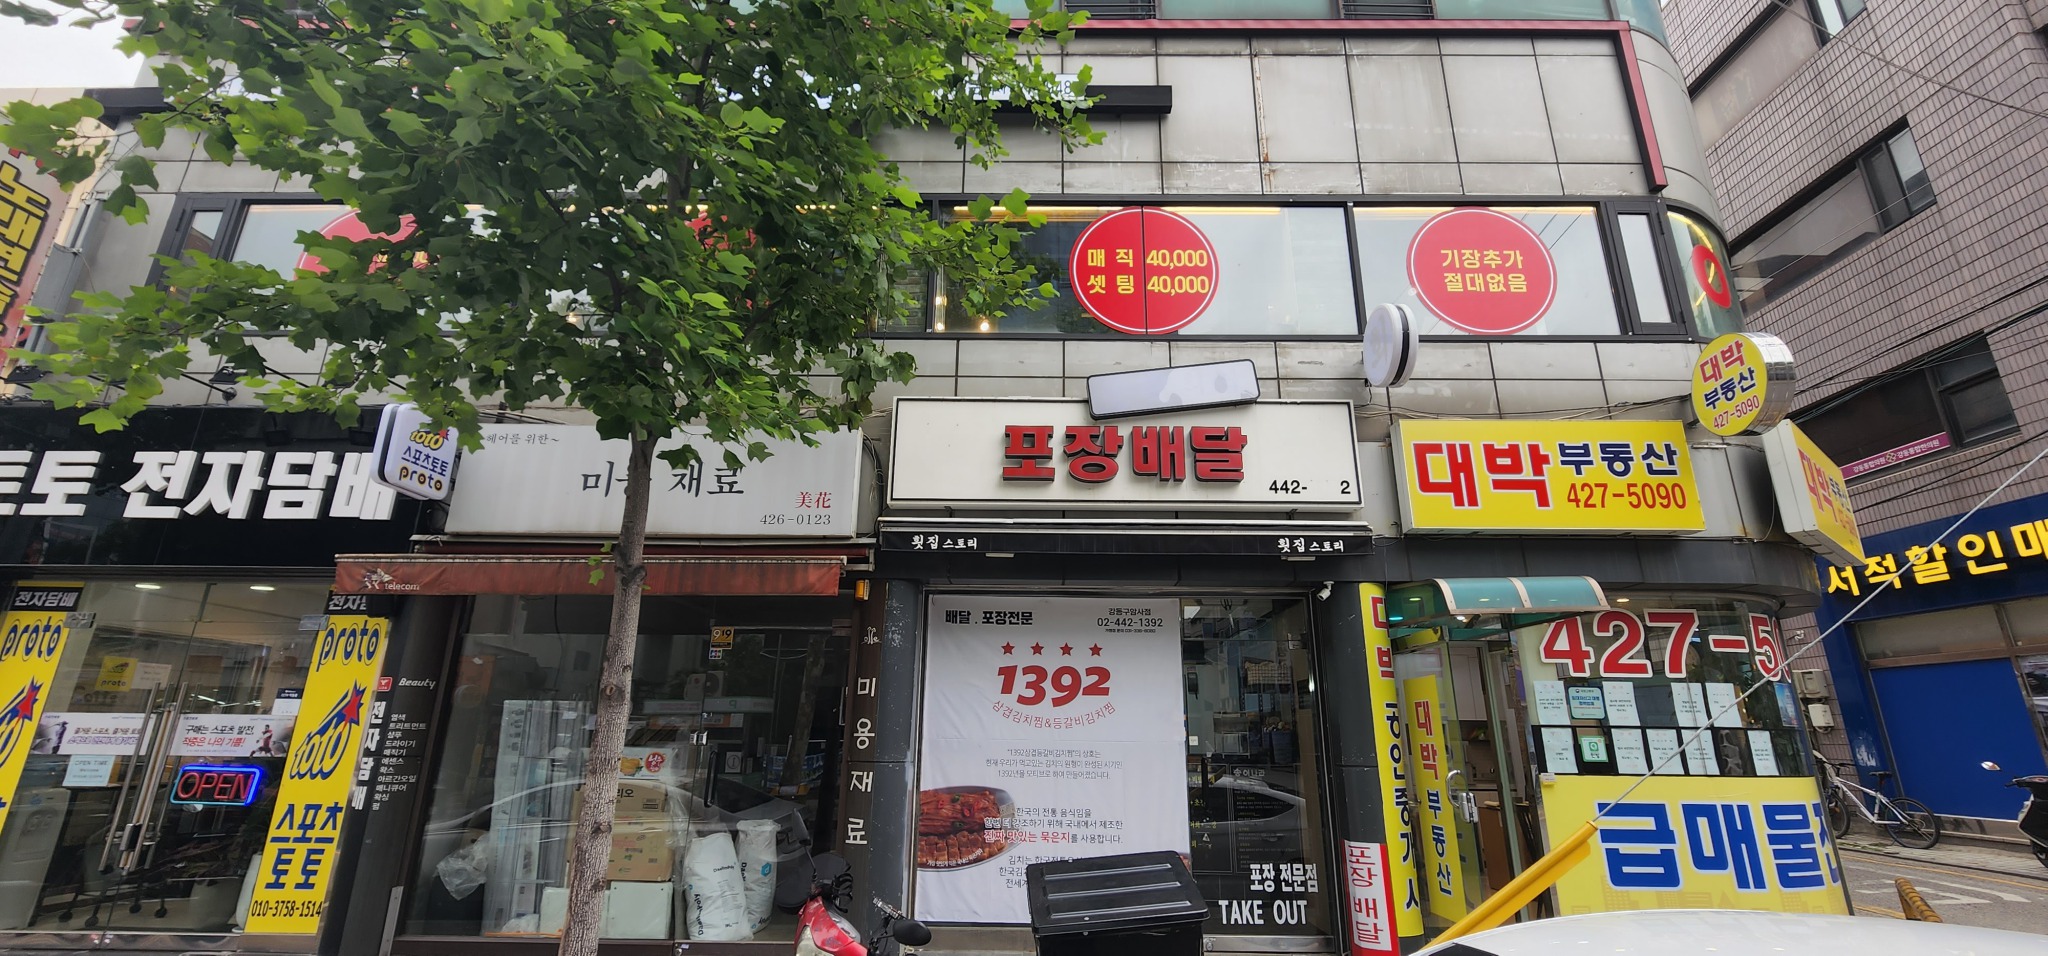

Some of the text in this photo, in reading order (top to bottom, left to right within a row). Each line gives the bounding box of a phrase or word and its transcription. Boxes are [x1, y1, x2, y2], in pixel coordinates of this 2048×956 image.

[1146, 250, 1208, 270] 40,000
[1440, 249, 1523, 269] 기장추가
[1147, 276, 1209, 296] 40,000
[1443, 272, 1528, 293] 절대없음
[1699, 339, 1745, 384] 대박
[1703, 366, 1756, 410] 부동산
[1713, 394, 1760, 430] 427-5090
[410, 429, 445, 451] toto
[401, 445, 449, 477] 스포츠토토
[1002, 424, 1248, 484] 포장배달
[121, 450, 398, 519] 전자담배
[399, 466, 443, 491] proto
[668, 461, 745, 497] 재료
[1411, 441, 1680, 510] 대박 부동산
[794, 491, 832, 509] 美花
[1567, 482, 1687, 510] 427-5090
[760, 513, 832, 526] 426-0123
[942, 536, 978, 550] 스토리
[1309, 539, 1345, 554] 스토리
[384, 581, 420, 591] telecom
[14, 591, 79, 608] 전자담배
[945, 610, 1033, 625] 배달 포장전문
[1097, 617, 1163, 627] 02-442-1392
[1108, 608, 1151, 616] 강동구암사점
[316, 620, 381, 672] proto
[398, 677, 436, 690] Beauty
[997, 664, 1111, 708] 1392
[992, 700, 1116, 729] 삼겹김치찜&등갈비김치찜
[209, 725, 235, 735] 스포츠
[387, 731, 402, 739] 샴푸
[388, 722, 427, 730] 트리트먼트
[207, 737, 226, 747] 나의
[384, 740, 416, 748] 드라이기
[999, 759, 1018, 767] 우리가
[176, 771, 255, 800] OPEN
[377, 775, 417, 783] 아르간오일
[1414, 700, 1452, 896] 대박 부동산
[270, 801, 343, 844] 스포츠
[1016, 807, 1092, 818] 한국의 전통 음식임을
[1012, 819, 1045, 829] 강조하기
[1047, 819, 1063, 829] 위해
[1065, 820, 1097, 829] 국내에서
[1098, 820, 1123, 830] 제조한
[984, 830, 1005, 842] 진짜
[1007, 830, 1037, 843] 맛있는
[1040, 831, 1078, 844] 묵은지를
[264, 848, 326, 890] 토토
[1008, 855, 1033, 866] 김치는
[1250, 863, 1319, 893] 포장 전문점
[1347, 844, 1385, 946] 포장 배달
[251, 900, 323, 918] 010-3758-1514
[1219, 900, 1308, 925] TAKE OUT
